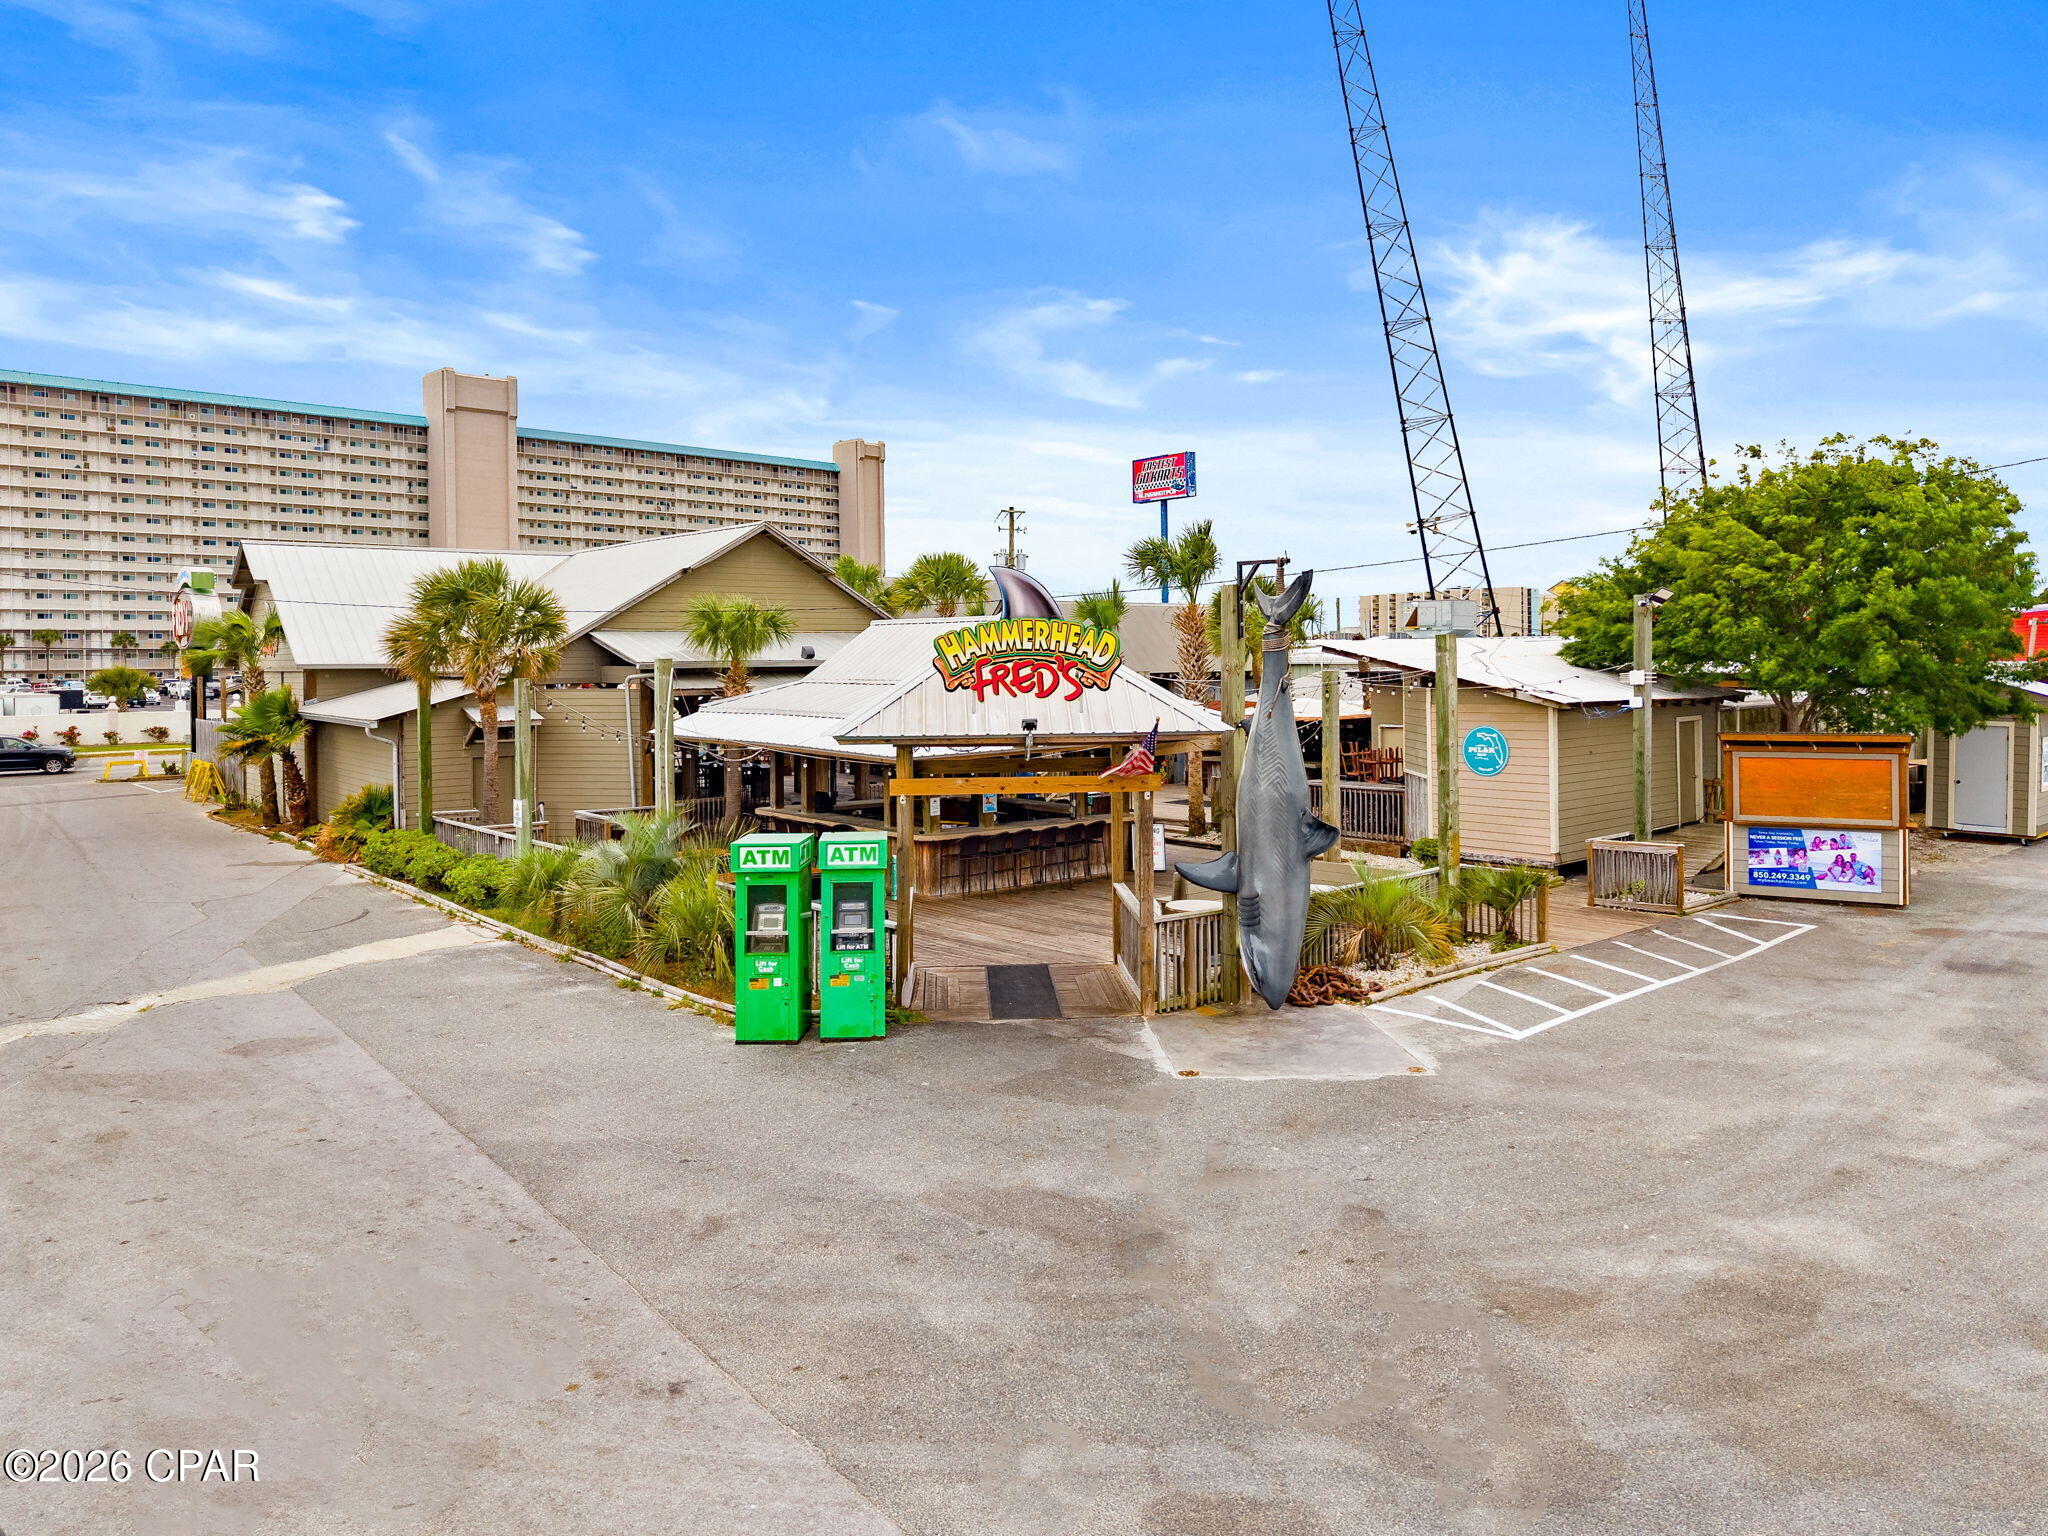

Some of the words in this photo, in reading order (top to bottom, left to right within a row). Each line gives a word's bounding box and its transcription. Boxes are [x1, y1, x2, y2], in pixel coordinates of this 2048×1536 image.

[1142, 457, 1178, 471] FASTEST
[1136, 472, 1150, 485] GO
[1150, 466, 1184, 483] KARTS
[936, 618, 1118, 671] HAMMERHEAD
[971, 655, 1084, 702] FRED'S
[742, 850, 789, 865] ATM
[830, 847, 876, 862] ATM
[1753, 871, 1810, 881] 850.249.3349
